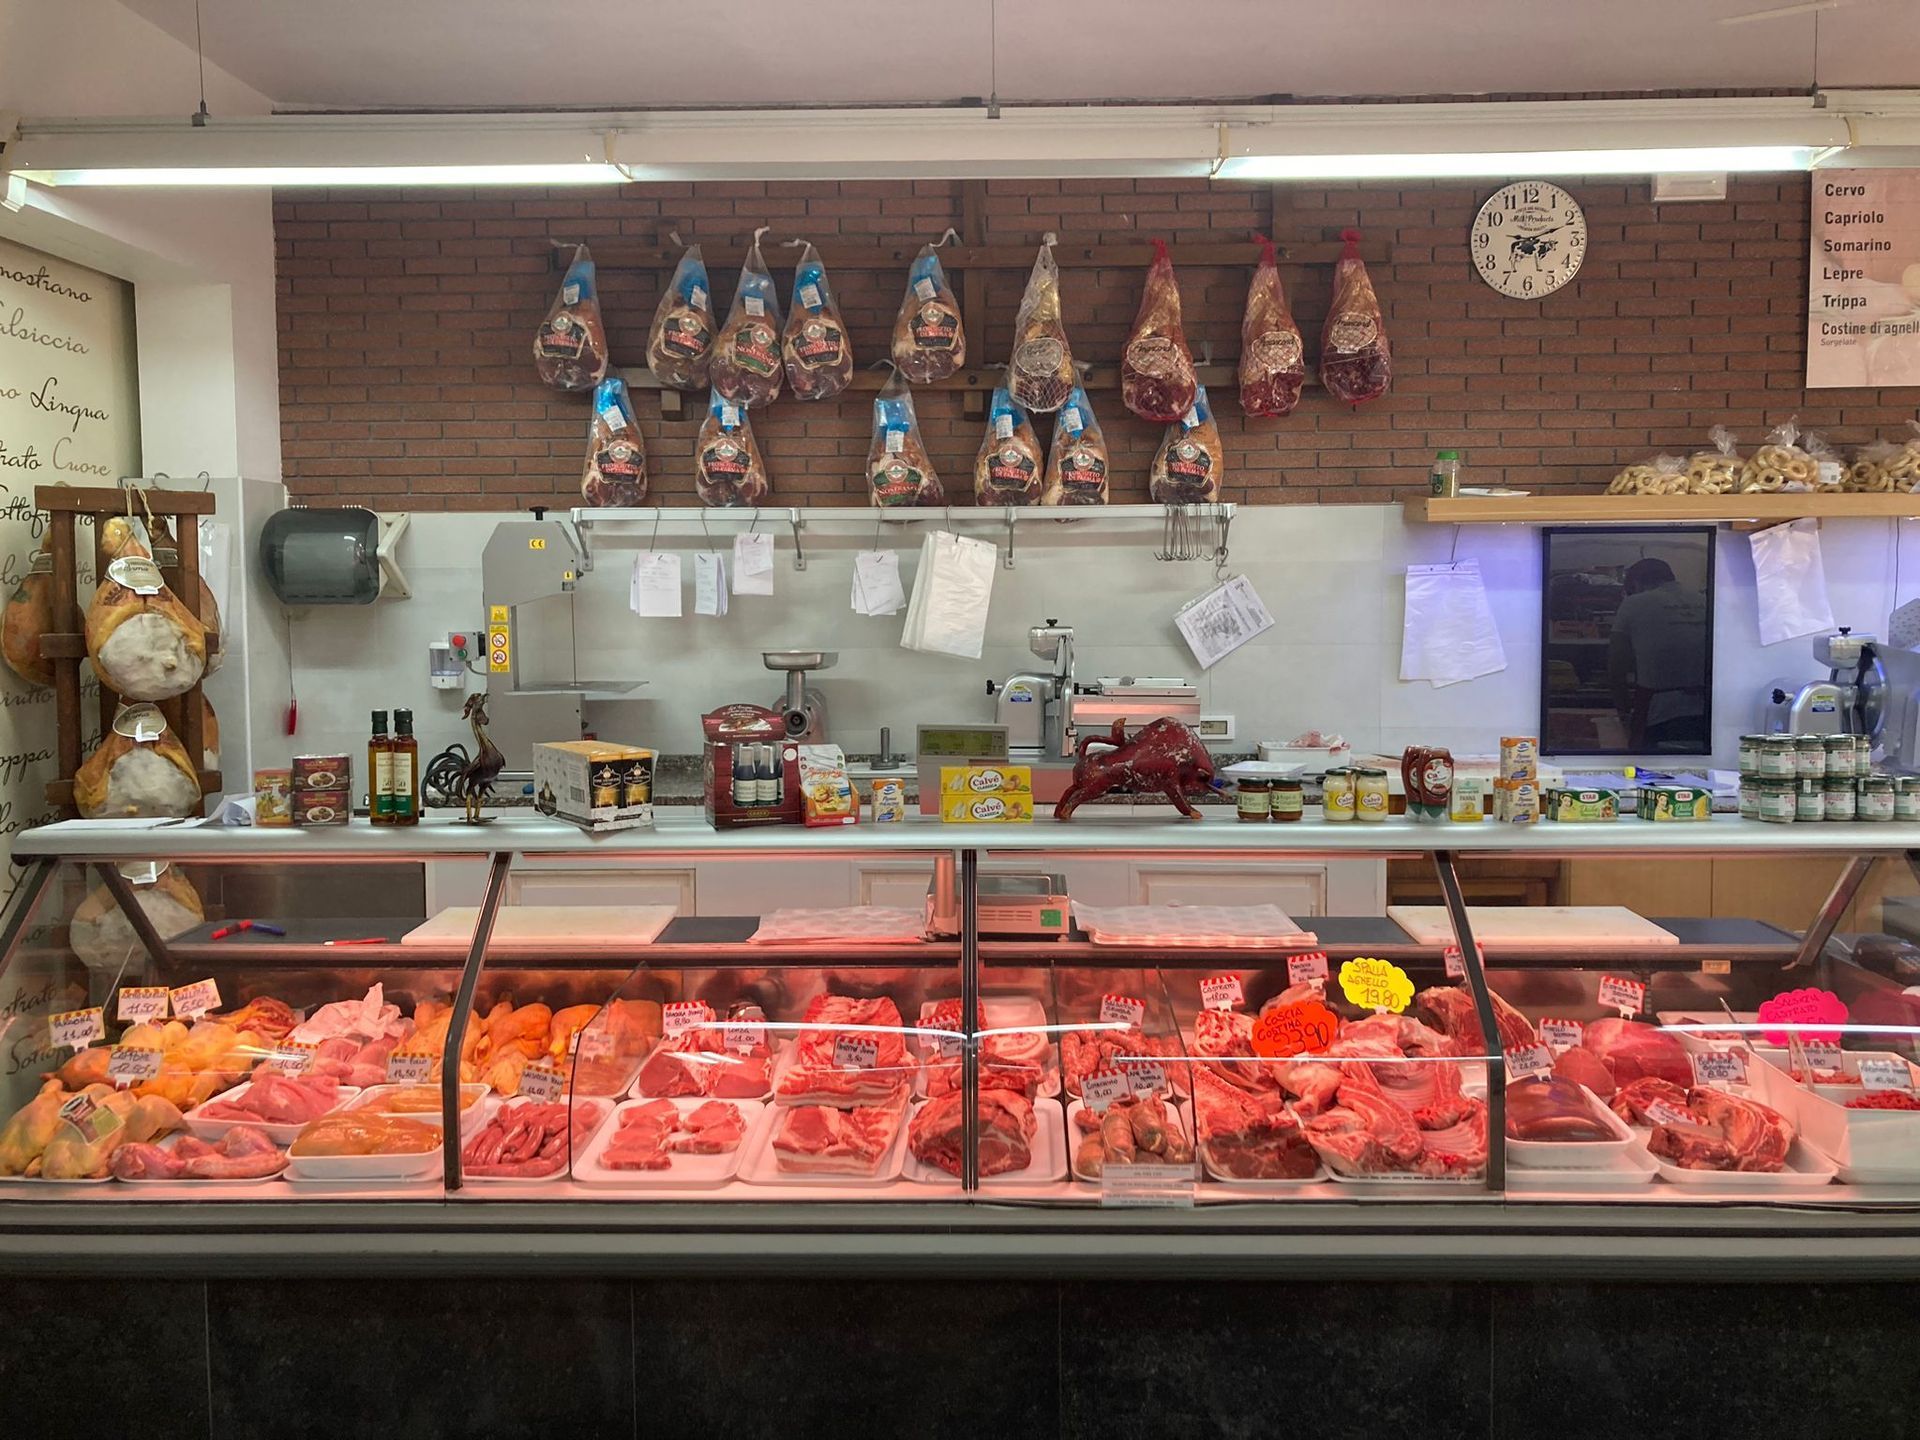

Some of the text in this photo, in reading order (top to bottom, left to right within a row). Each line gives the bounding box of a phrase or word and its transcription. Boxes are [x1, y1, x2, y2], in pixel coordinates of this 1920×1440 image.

[1523, 188, 1539, 204] 12
[1825, 183, 1866, 197] Cervo
[1504, 195, 1516, 209] 11
[1551, 194, 1556, 209] 1
[1488, 212, 1503, 227] 10
[1565, 210, 1575, 225] 2
[1824, 211, 1885, 227] Capriolo
[1479, 233, 1489, 248] 9
[1570, 231, 1580, 247] 3
[1824, 238, 1892, 253] Somarino
[1486, 254, 1496, 270] 8
[1561, 253, 1571, 269] 4
[1502, 271, 1511, 285] 7
[1545, 270, 1556, 285] 5
[1823, 267, 1864, 282] Lepre
[1522, 276, 1533, 291] 6
[1822, 294, 1867, 310] Trippa
[1821, 321, 1920, 337] Costine di agnell
[30, 377, 110, 432] Lingua
[53, 437, 111, 476] Cuore
[972, 774, 1000, 787] Calvé
[974, 802, 1002, 814] Calvé
[1353, 962, 1388, 977] SPALLA
[1264, 1007, 1303, 1027] COSCIA
